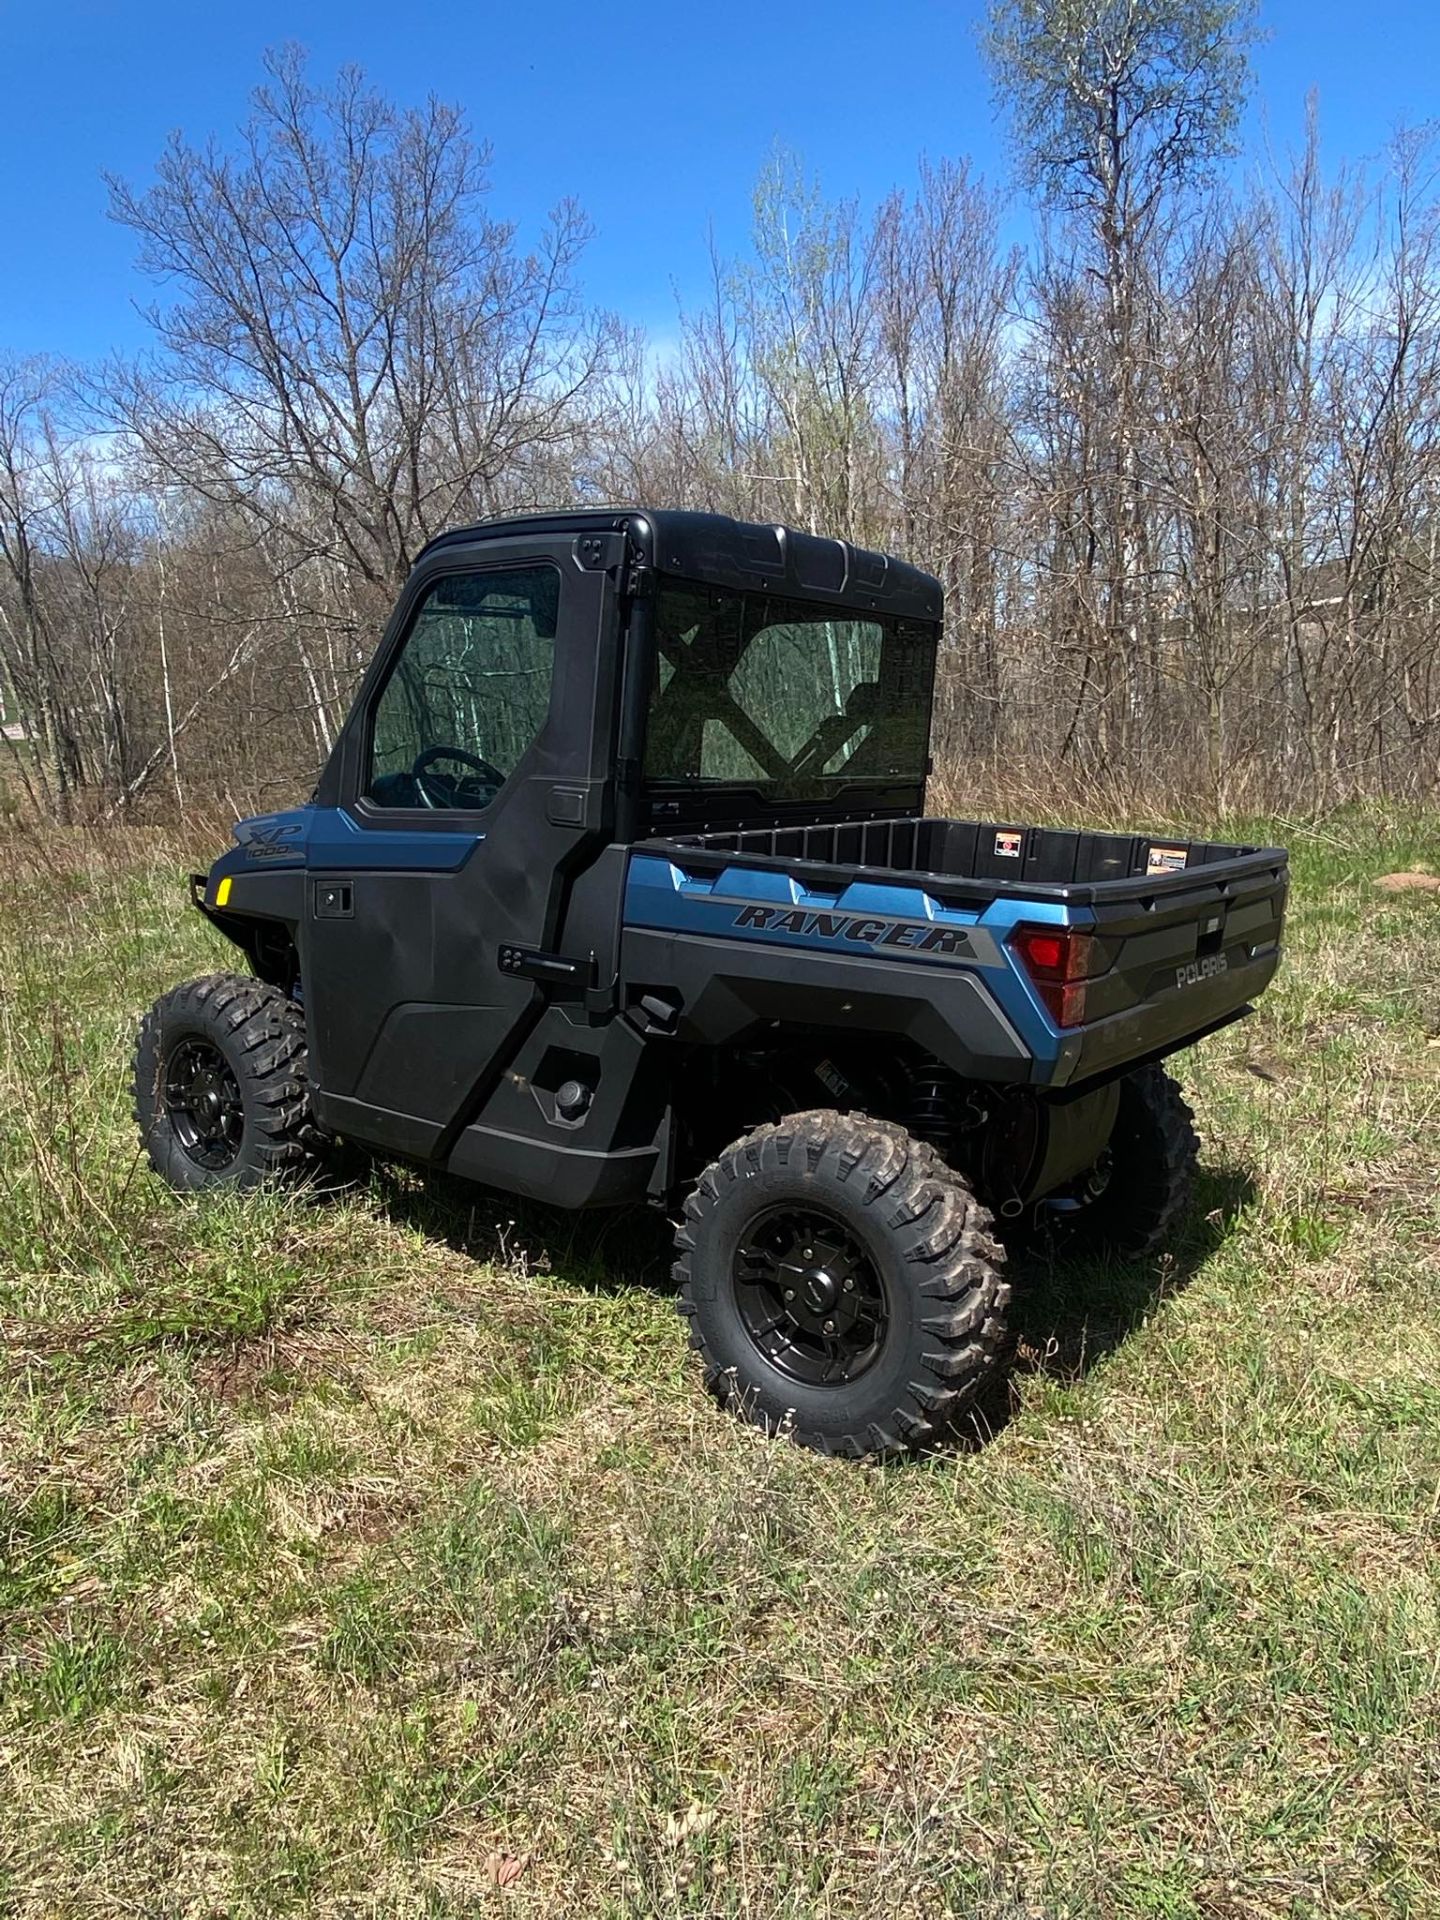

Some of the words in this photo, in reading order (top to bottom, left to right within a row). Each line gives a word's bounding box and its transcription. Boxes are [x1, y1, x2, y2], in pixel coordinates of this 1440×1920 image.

[243, 825, 302, 846] XP
[248, 845, 289, 858] 1000
[733, 904, 969, 953] RANGER
[1175, 952, 1228, 989] POLARIS
